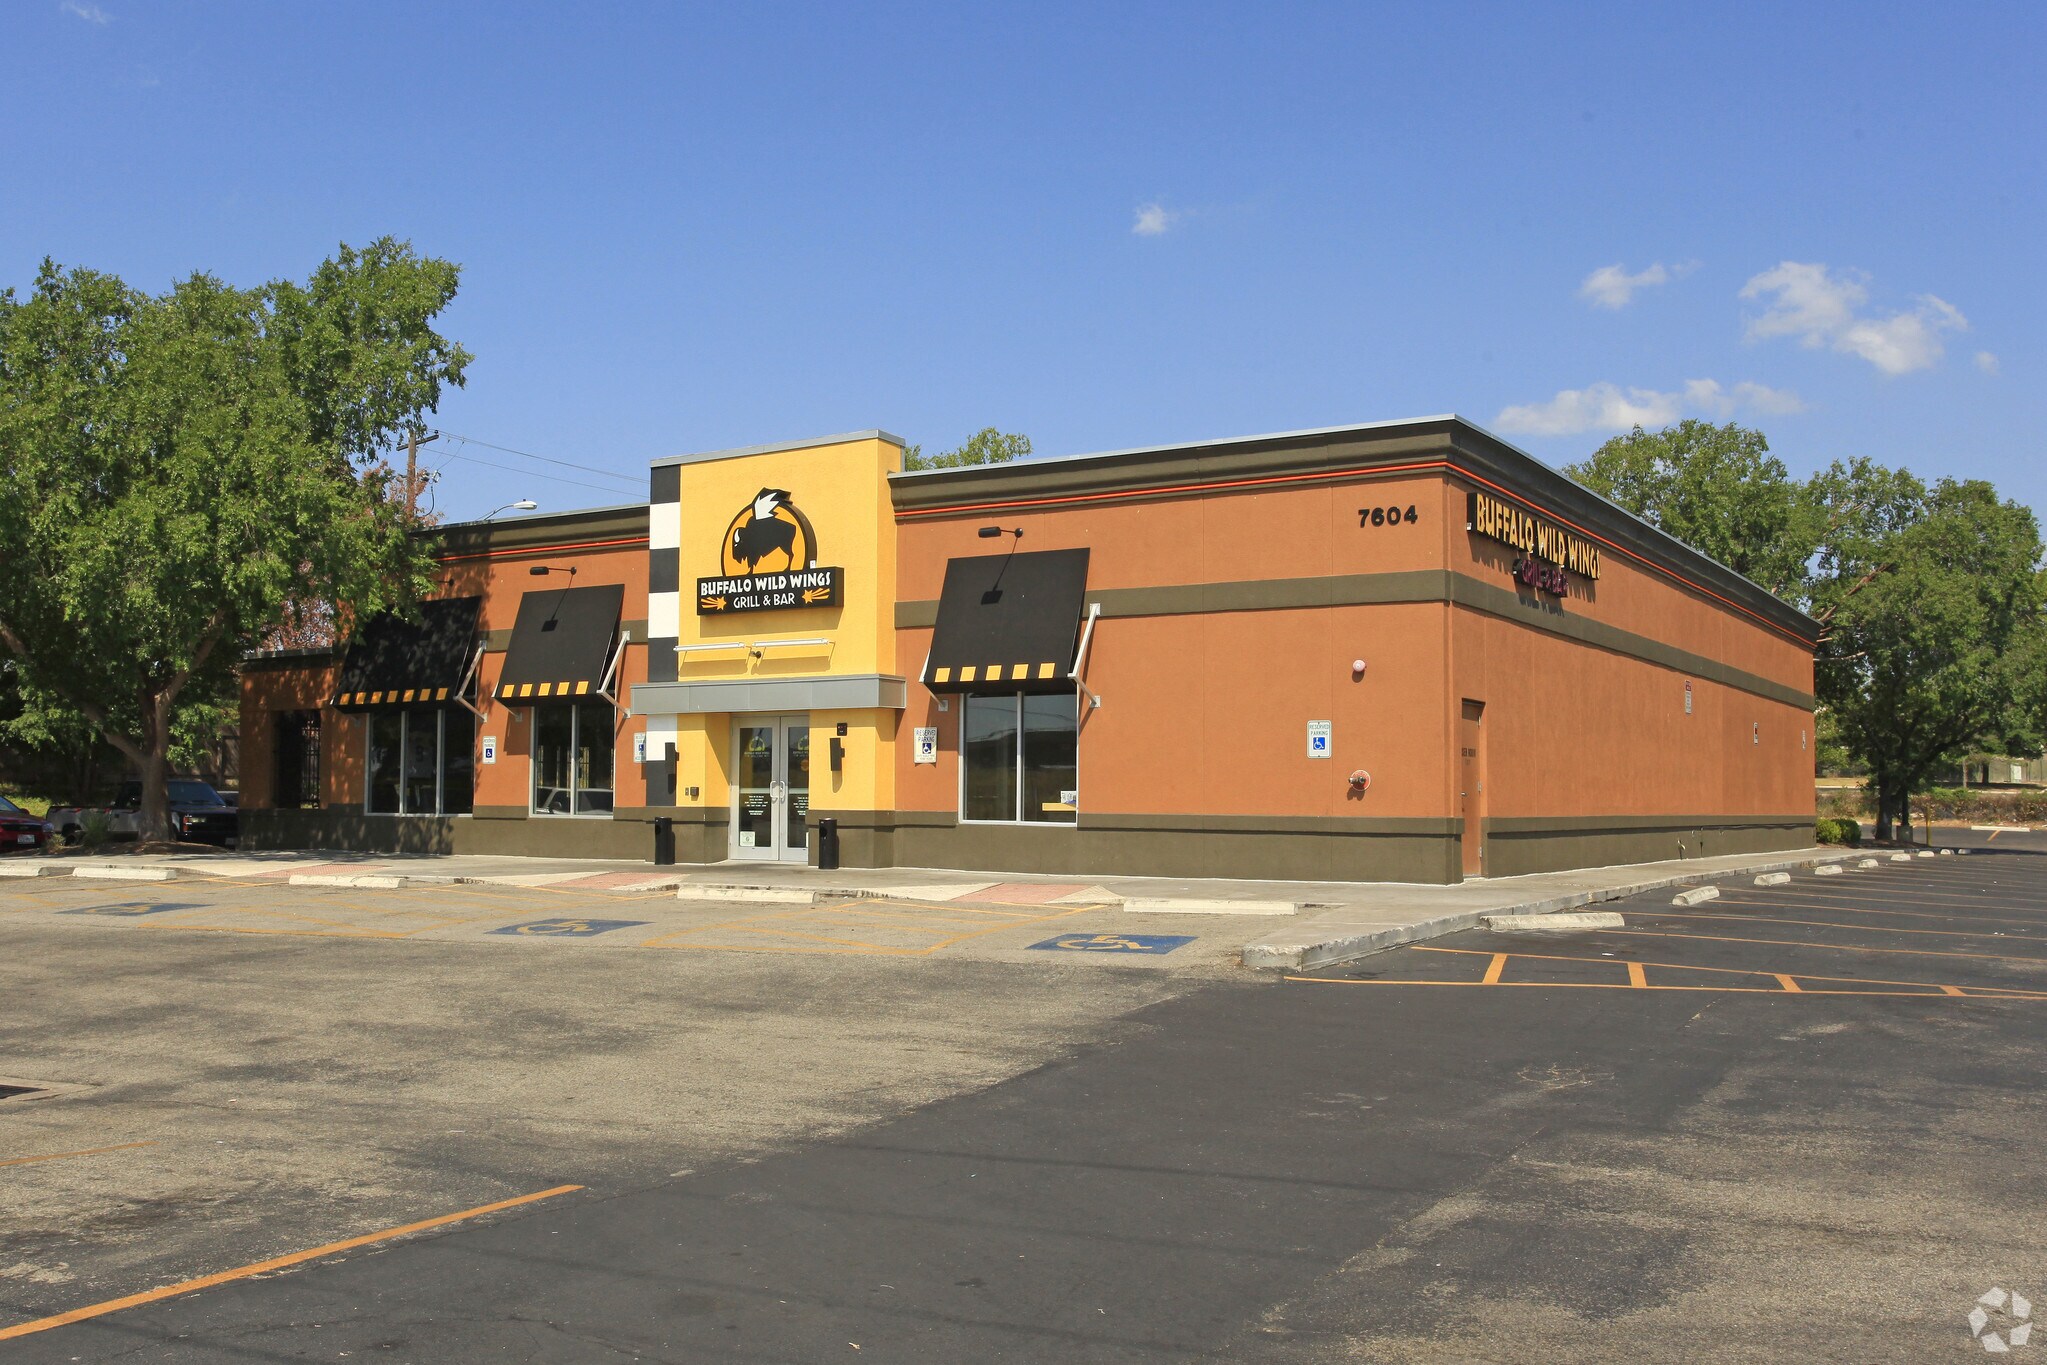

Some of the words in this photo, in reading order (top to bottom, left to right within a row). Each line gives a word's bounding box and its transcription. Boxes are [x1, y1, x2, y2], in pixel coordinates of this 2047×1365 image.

[1358, 505, 1418, 528] 7604
[1477, 493, 1534, 552] BUFFALO
[1537, 520, 1566, 565] WILD
[1567, 535, 1600, 579] WINGS
[700, 579, 751, 596] BUFFALO
[755, 575, 787, 591] WILD
[789, 572, 831, 589] WINGS
[733, 594, 760, 609] GRILL
[762, 594, 771, 606] &
[773, 592, 795, 606] BAR
